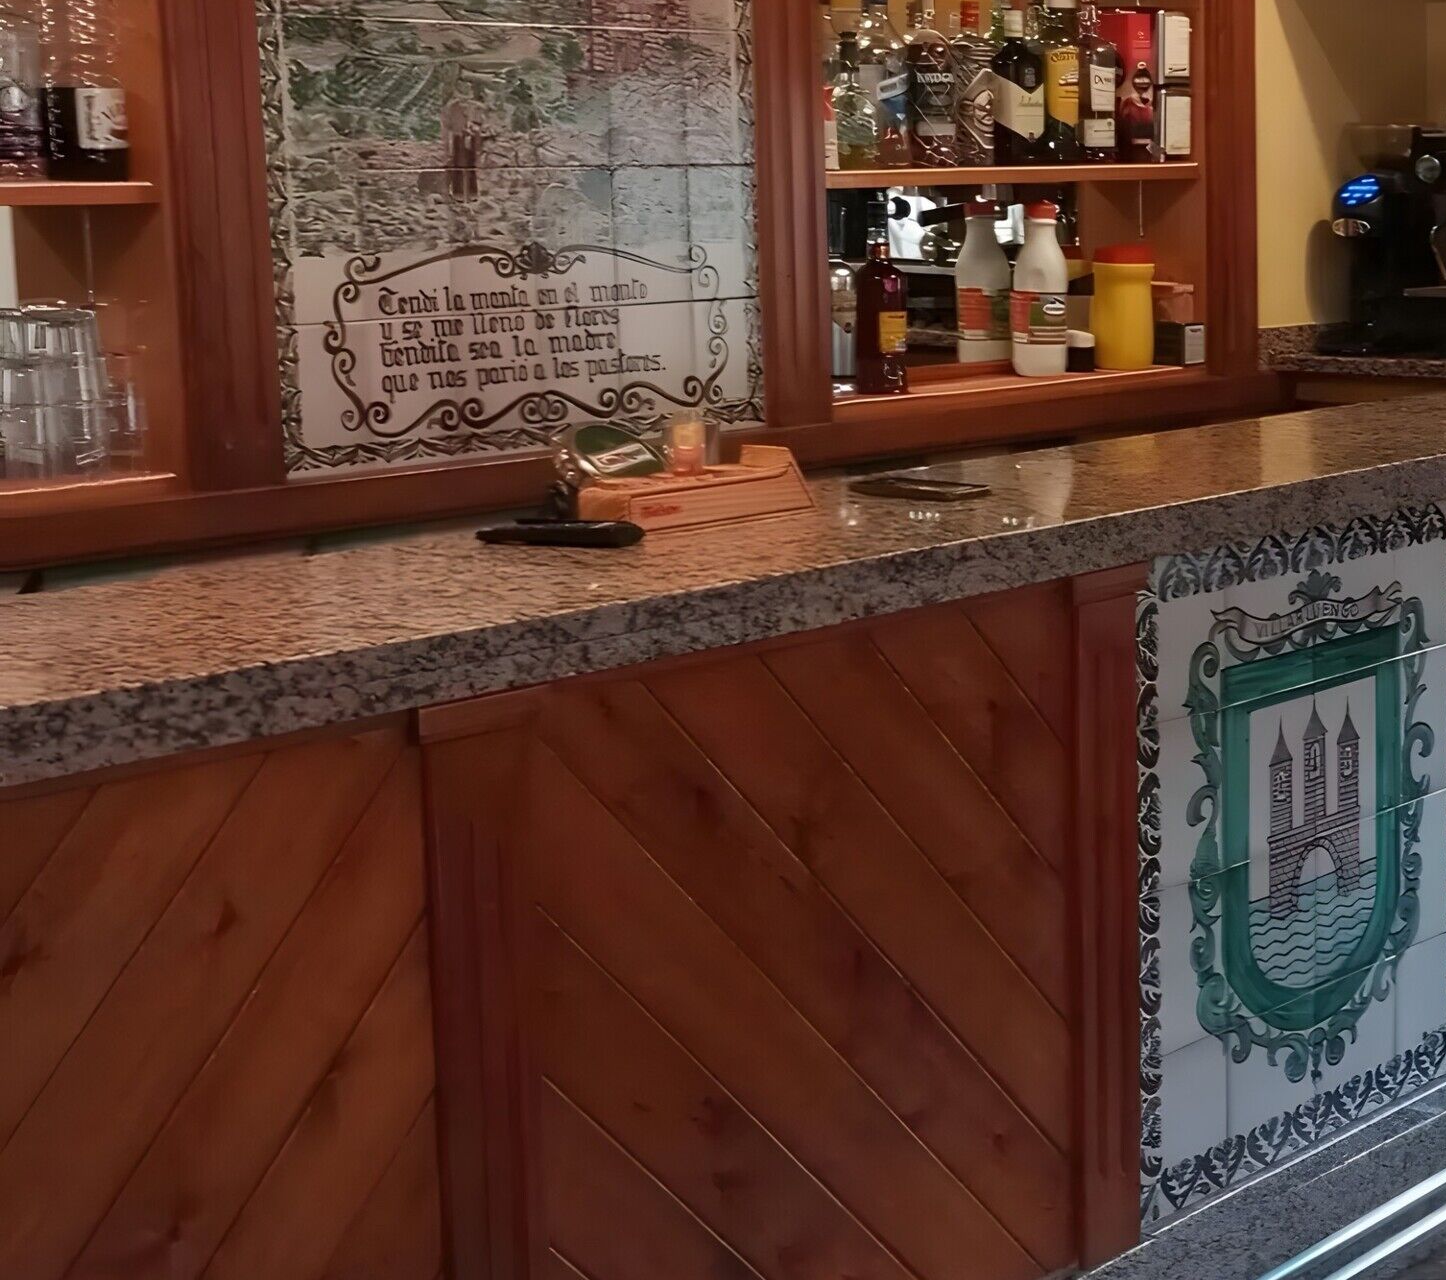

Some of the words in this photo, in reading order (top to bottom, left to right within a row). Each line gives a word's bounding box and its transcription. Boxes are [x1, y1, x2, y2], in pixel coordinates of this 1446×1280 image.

[442, 285, 467, 312] la
[537, 288, 559, 306] en
[564, 281, 580, 304] el
[401, 320, 423, 341] se
[430, 318, 464, 338] me
[534, 308, 555, 331] de
[468, 340, 503, 361] sea
[511, 334, 539, 358] la
[547, 328, 617, 354] madre
[381, 372, 420, 405] que
[427, 370, 468, 390] nos
[533, 362, 548, 380] a
[551, 356, 580, 379] los
